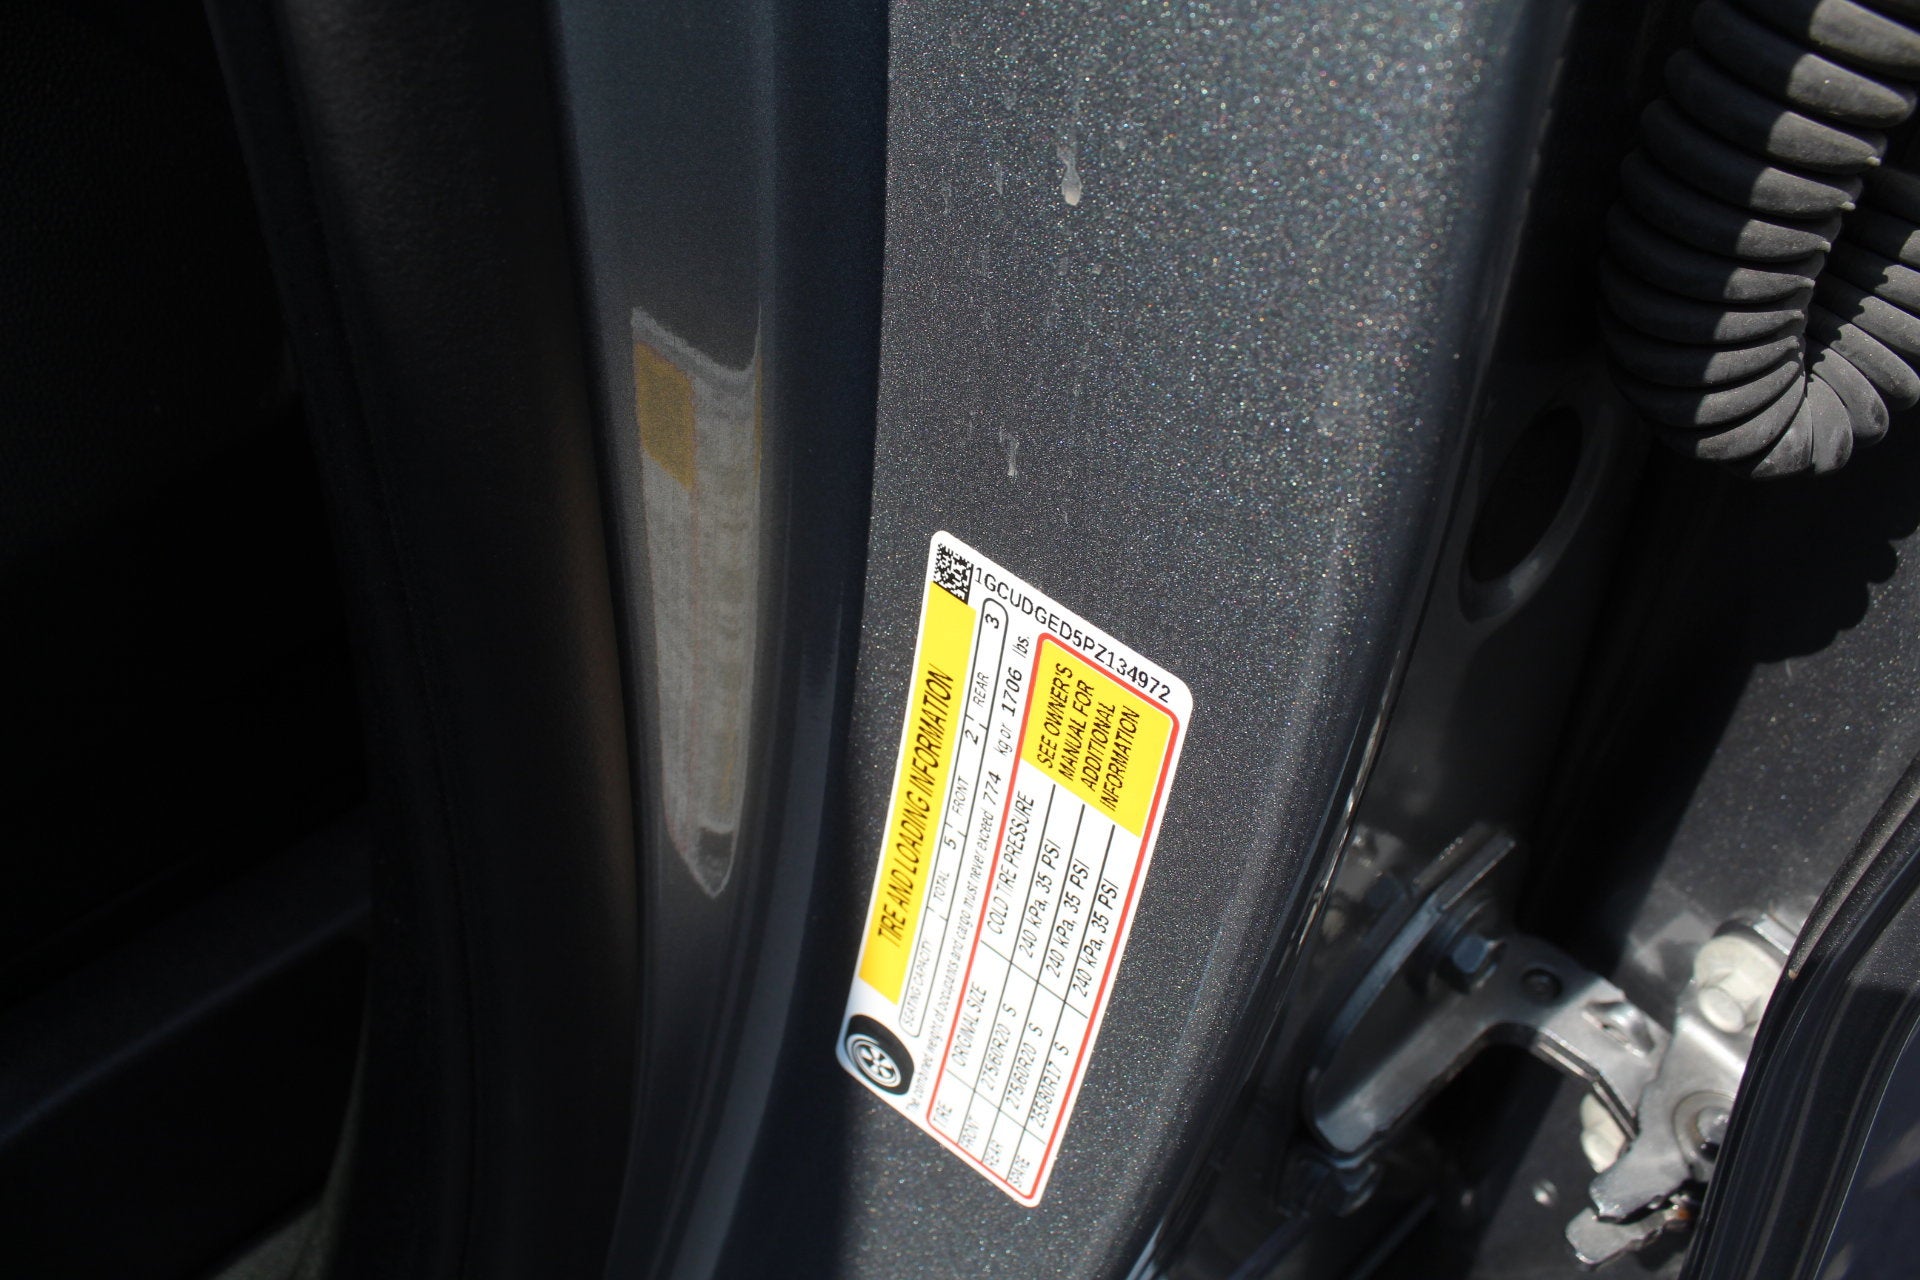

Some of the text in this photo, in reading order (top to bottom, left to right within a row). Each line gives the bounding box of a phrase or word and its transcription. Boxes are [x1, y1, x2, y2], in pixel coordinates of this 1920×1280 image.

[972, 611, 999, 707] REAR 3
[974, 566, 1173, 702] 1GCUDGED5PZ134972
[1011, 628, 1030, 658] lbs.
[999, 665, 1024, 717] 1706
[999, 722, 1012, 740] or
[1035, 660, 1073, 770] SEE OWNER'S
[1056, 678, 1095, 781] MANUAL FOR
[951, 727, 978, 816] FRONT 2
[982, 768, 1002, 807] 774
[994, 736, 1012, 759] kg
[1079, 695, 1116, 792] ADDITIONAL
[1099, 704, 1140, 812] INFORMATION
[877, 662, 954, 950] TIRE AND LOADING INFORMATION
[973, 807, 994, 852] exceed
[933, 834, 956, 903] TOTAL 5
[961, 879, 977, 910] must
[967, 848, 984, 882] never
[986, 789, 1034, 937] COLD TIRE PRESSURE
[1018, 837, 1061, 959] 240 kPa, 35 PSI
[949, 937, 963, 961] and
[954, 908, 974, 944] cargo
[1045, 857, 1089, 979] 240 kPa, 35 PSI
[1071, 876, 1118, 998] 240 kPa, 35 PSI
[902, 937, 933, 1029] SEATING CAPACITY
[950, 979, 986, 1069] ORIGINAL SIZE
[980, 1000, 1017, 1091] 275/60R20 S
[1005, 1019, 1043, 1111] 275/60R20 S
[1030, 1039, 1070, 1129] 255/80R17 S
[933, 1098, 952, 1131] TIRE
